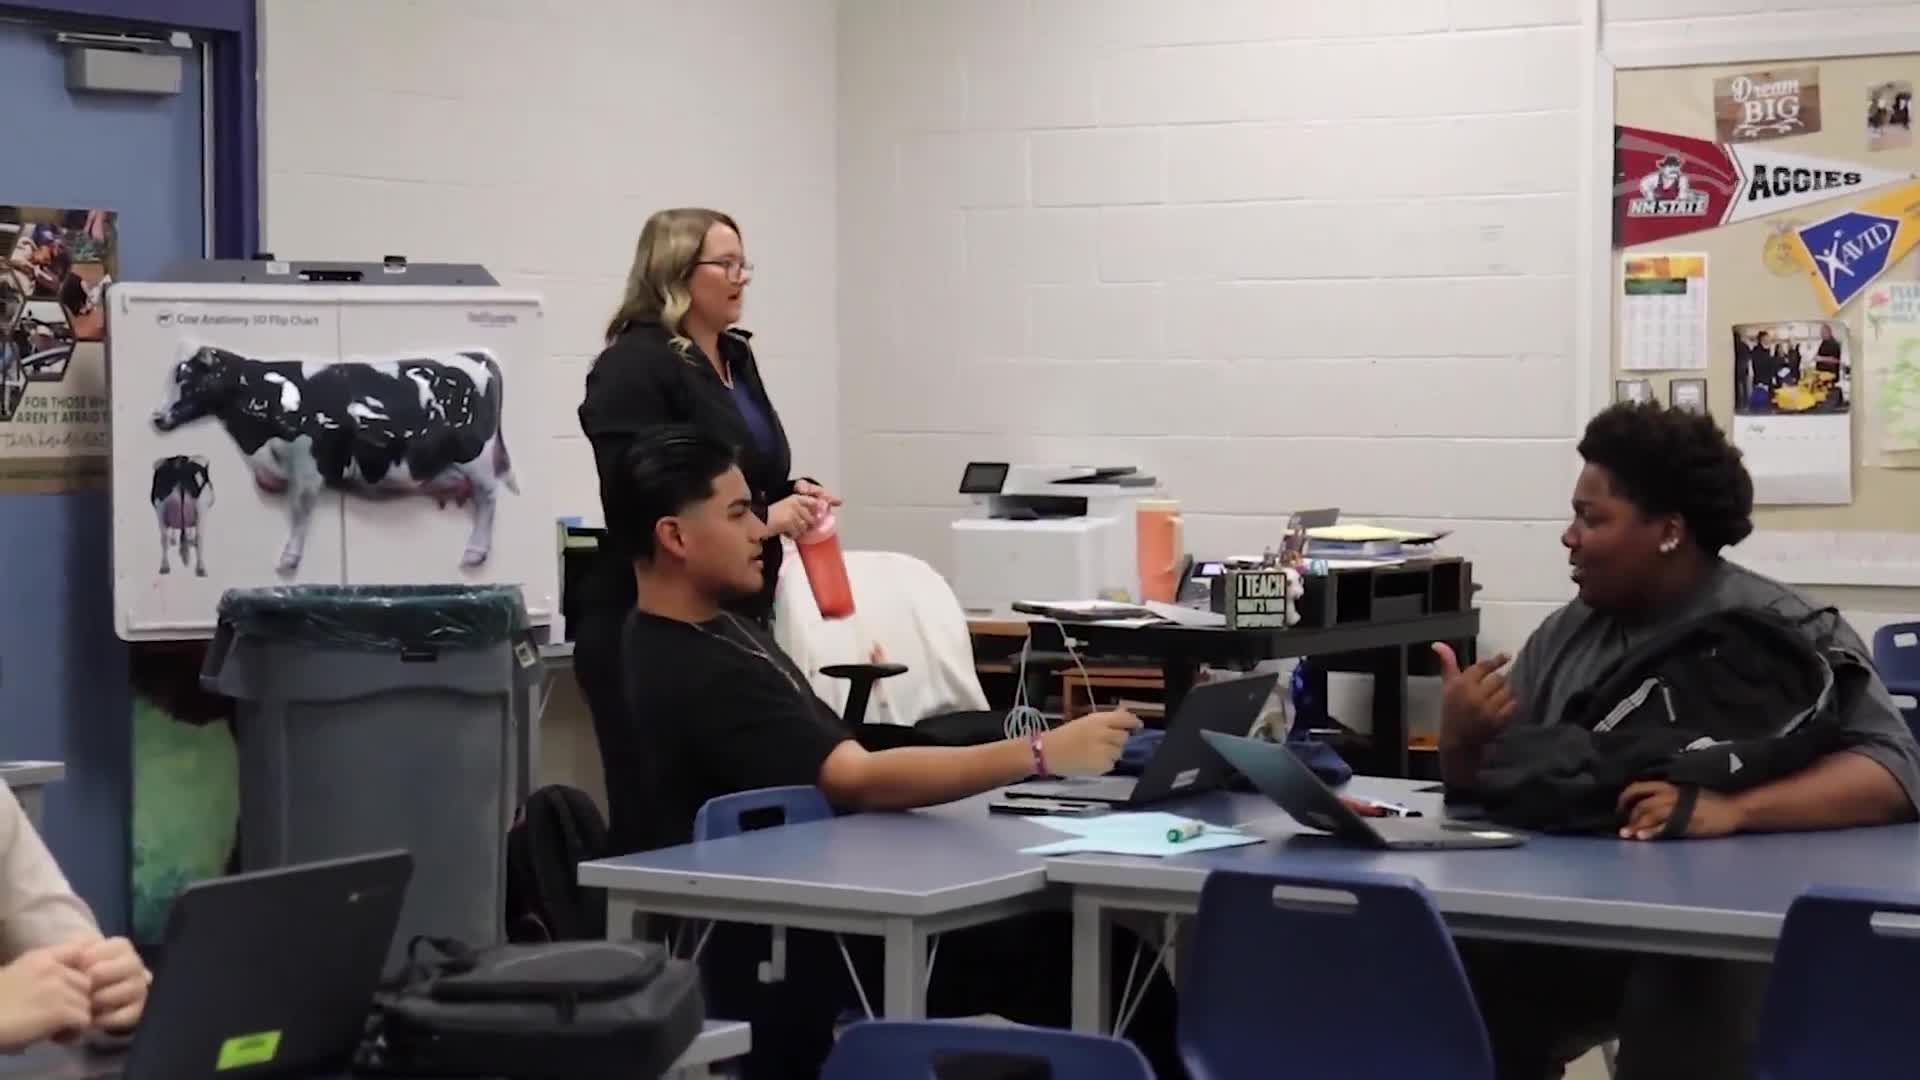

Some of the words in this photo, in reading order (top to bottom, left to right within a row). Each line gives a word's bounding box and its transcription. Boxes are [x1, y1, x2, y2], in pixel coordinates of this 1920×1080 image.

[1731, 77, 1801, 102] Dream
[1744, 96, 1801, 124] BIG
[1748, 164, 1862, 202] AGGIES
[1631, 199, 1654, 214] NM
[1653, 197, 1707, 214] STATE
[1842, 222, 1892, 264] AVID
[24, 396, 48, 409] FOR
[51, 396, 87, 409] THOSE
[16, 411, 58, 424] AREN'T
[1237, 574, 1244, 597] I
[1245, 574, 1285, 598] TEACH
